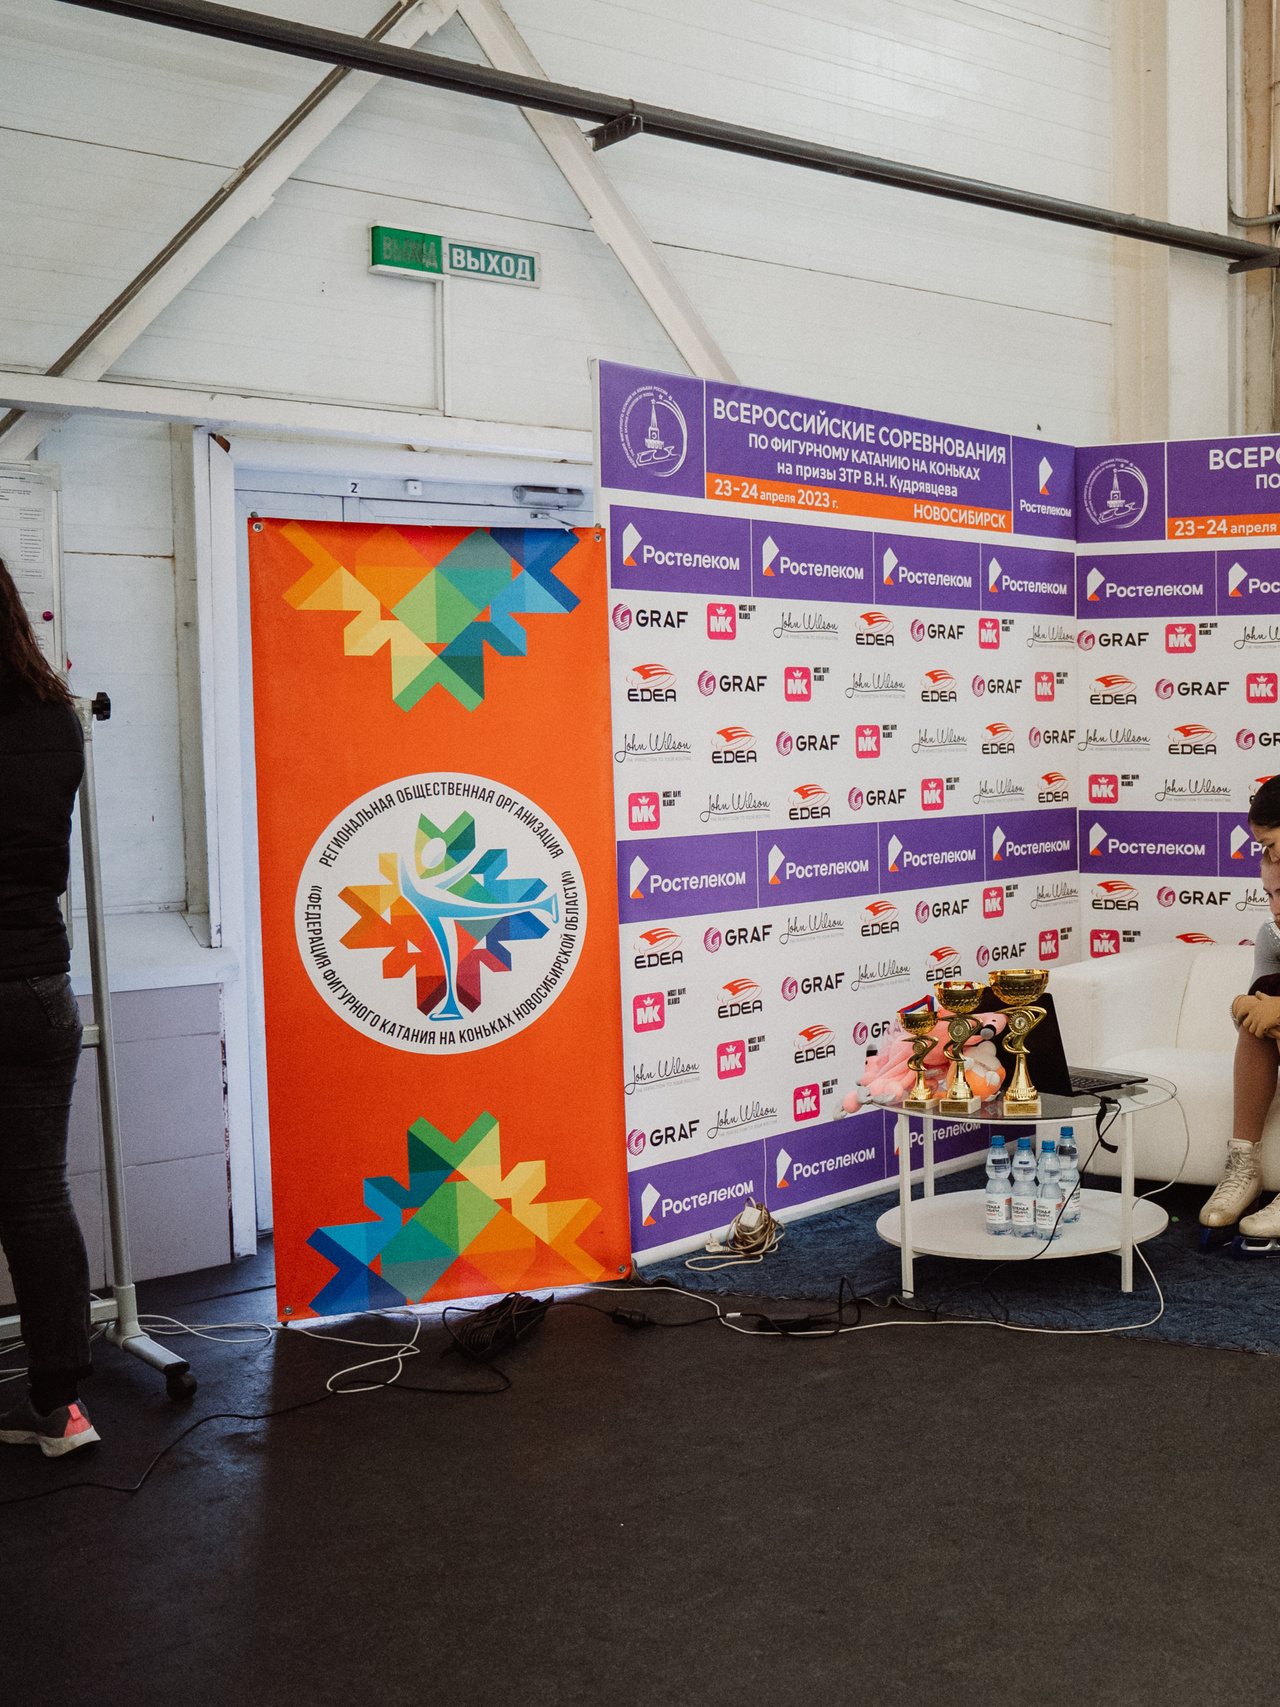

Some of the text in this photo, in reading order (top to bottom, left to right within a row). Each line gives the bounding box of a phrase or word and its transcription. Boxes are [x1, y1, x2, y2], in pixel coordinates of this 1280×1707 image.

[452, 247, 531, 281] ВЫХОД
[713, 398, 876, 444] ВСЕРОССИЙСКИЕ
[878, 427, 1007, 465] СОРЕВНОВАНИЯ
[749, 433, 980, 481] ПО ФИГУРНОМУ КАТАНИЮ НА КОНЬКАХ
[350, 482, 359, 493] 2
[777, 462, 959, 497] на призы ЗТР В.Н. Кудрявцева
[760, 491, 796, 505] апреля
[797, 489, 830, 508] 2023
[832, 500, 839, 509] г.
[1020, 499, 1071, 517] Ростелеком
[913, 503, 1007, 529] НОВОСИБИРСК
[1230, 523, 1278, 536] апреля
[643, 545, 740, 570] Ростелеком
[780, 556, 864, 580] Ростелеком
[899, 566, 972, 588] Ростелеком
[1002, 575, 1067, 595] Ростелеком
[1106, 583, 1203, 598] Ростелеком
[636, 609, 688, 628] GRAF
[710, 615, 733, 633] MK
[855, 633, 894, 646] EDEA
[927, 624, 965, 640] GRAF
[1099, 632, 1149, 647] GRAF
[1168, 633, 1193, 648] MK
[719, 675, 767, 692] GRAF
[1177, 681, 1230, 696] GRAF
[1250, 683, 1274, 697] MK
[627, 688, 676, 702] EDEA
[1090, 694, 1137, 705] EDEA
[614, 731, 691, 763] John Wilson
[796, 734, 840, 751] GRAF
[1168, 744, 1217, 755] EDEA
[712, 750, 757, 764] EDEA
[866, 788, 907, 806] GRAF
[632, 805, 656, 823] MK
[789, 806, 830, 820] EDEA
[318, 781, 565, 868] РЕГИОНАЛЬНАЯ ОБЩЕСТВЕННАЯ ОРГАНИЗАЦИЯ
[1006, 840, 1070, 857] Ростелеком
[1108, 839, 1205, 855] Ростелеком
[903, 849, 976, 867] Ростелеком
[786, 859, 869, 880] Ростелеком
[650, 871, 746, 893] Ростелеком
[1092, 899, 1139, 911] EDEA
[1179, 890, 1231, 905] GRAF
[932, 899, 969, 918] GRAF
[725, 924, 772, 946] GRAF
[861, 921, 899, 937] EDEA
[304, 870, 579, 1045] «ФЕДЕРАЦИЯ ФИГУРНОГО КАТАНИЯ НА КОНЬКАХ НОВОСИБИРСКОЙ ОБЛАСТИ»
[634, 950, 683, 969] EDEA
[801, 972, 845, 994] GRAF
[637, 1005, 662, 1025] MK
[718, 1000, 763, 1019] EDEA
[794, 1044, 836, 1064] EDEA
[650, 1119, 700, 1147] GRAF
[909, 1122, 981, 1149] Ротелеком
[793, 1147, 875, 1181] Ростелеком
[661, 1179, 754, 1217] Ростелеком
